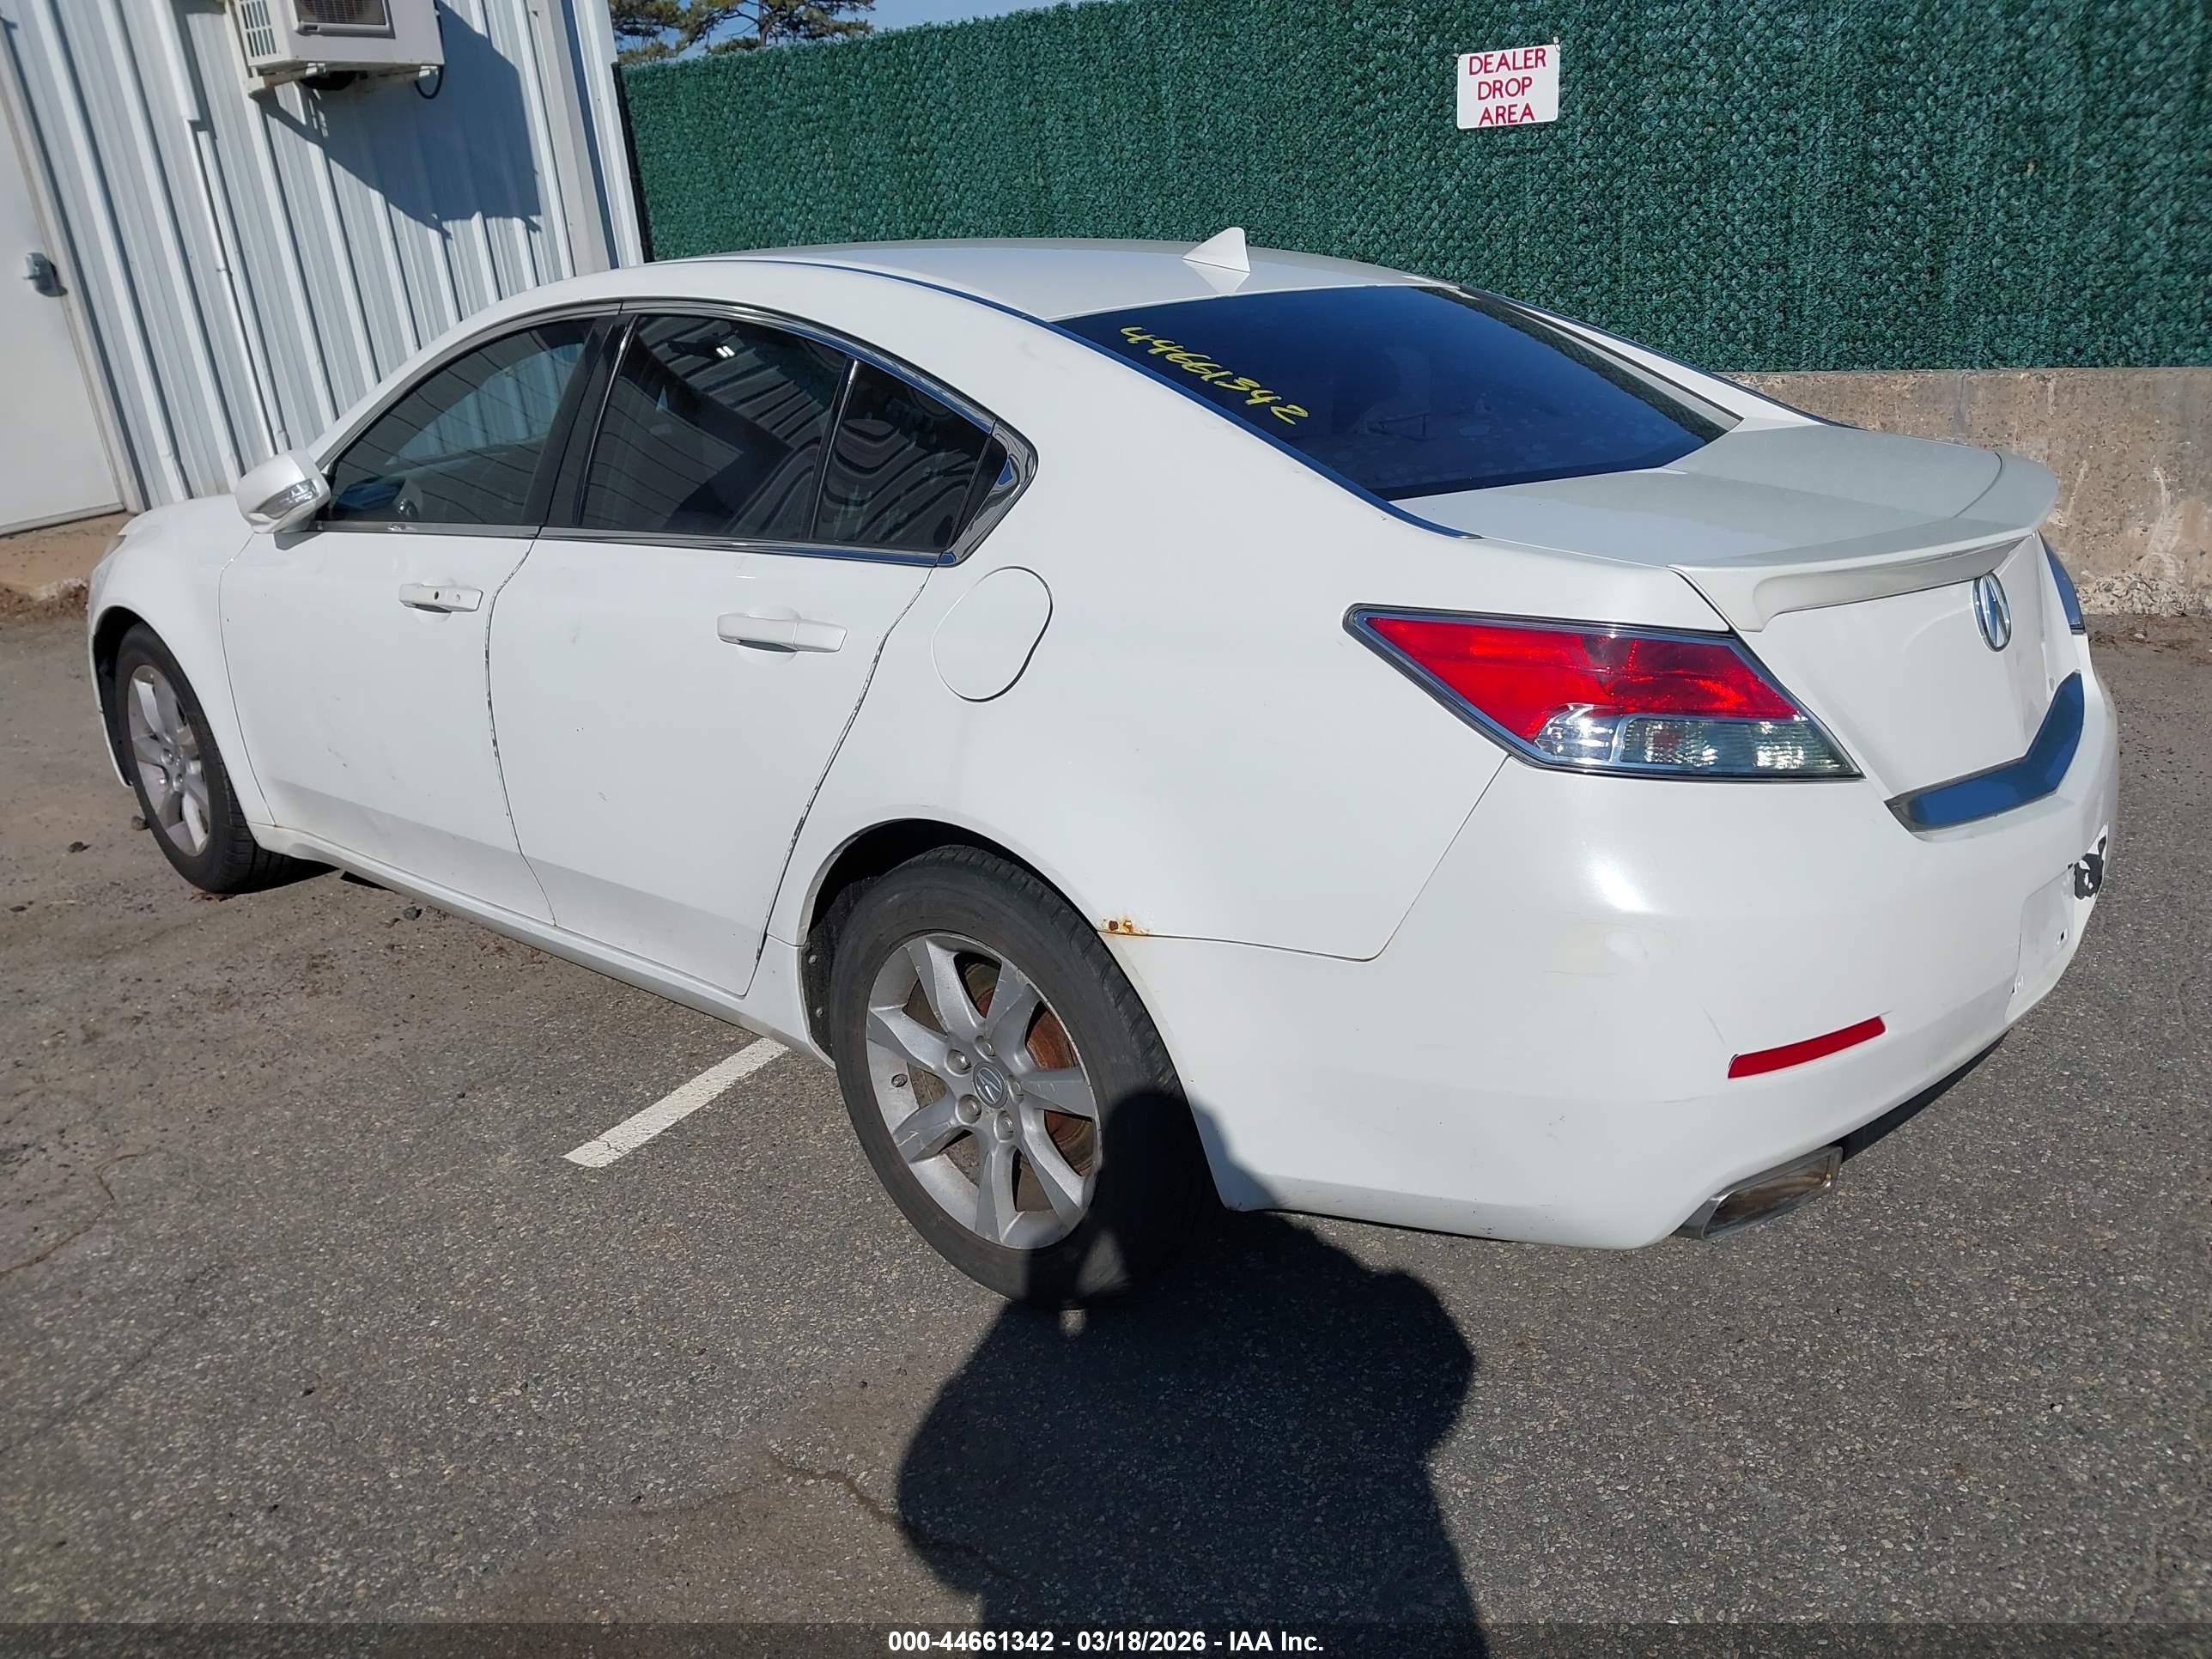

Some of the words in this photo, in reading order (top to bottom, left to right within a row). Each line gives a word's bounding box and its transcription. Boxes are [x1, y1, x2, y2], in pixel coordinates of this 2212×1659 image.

[1469, 48, 1547, 76] DEALER
[1478, 76, 1533, 100] DROP
[1479, 103, 1535, 126] AREA
[1120, 326, 1309, 425] 44661342
